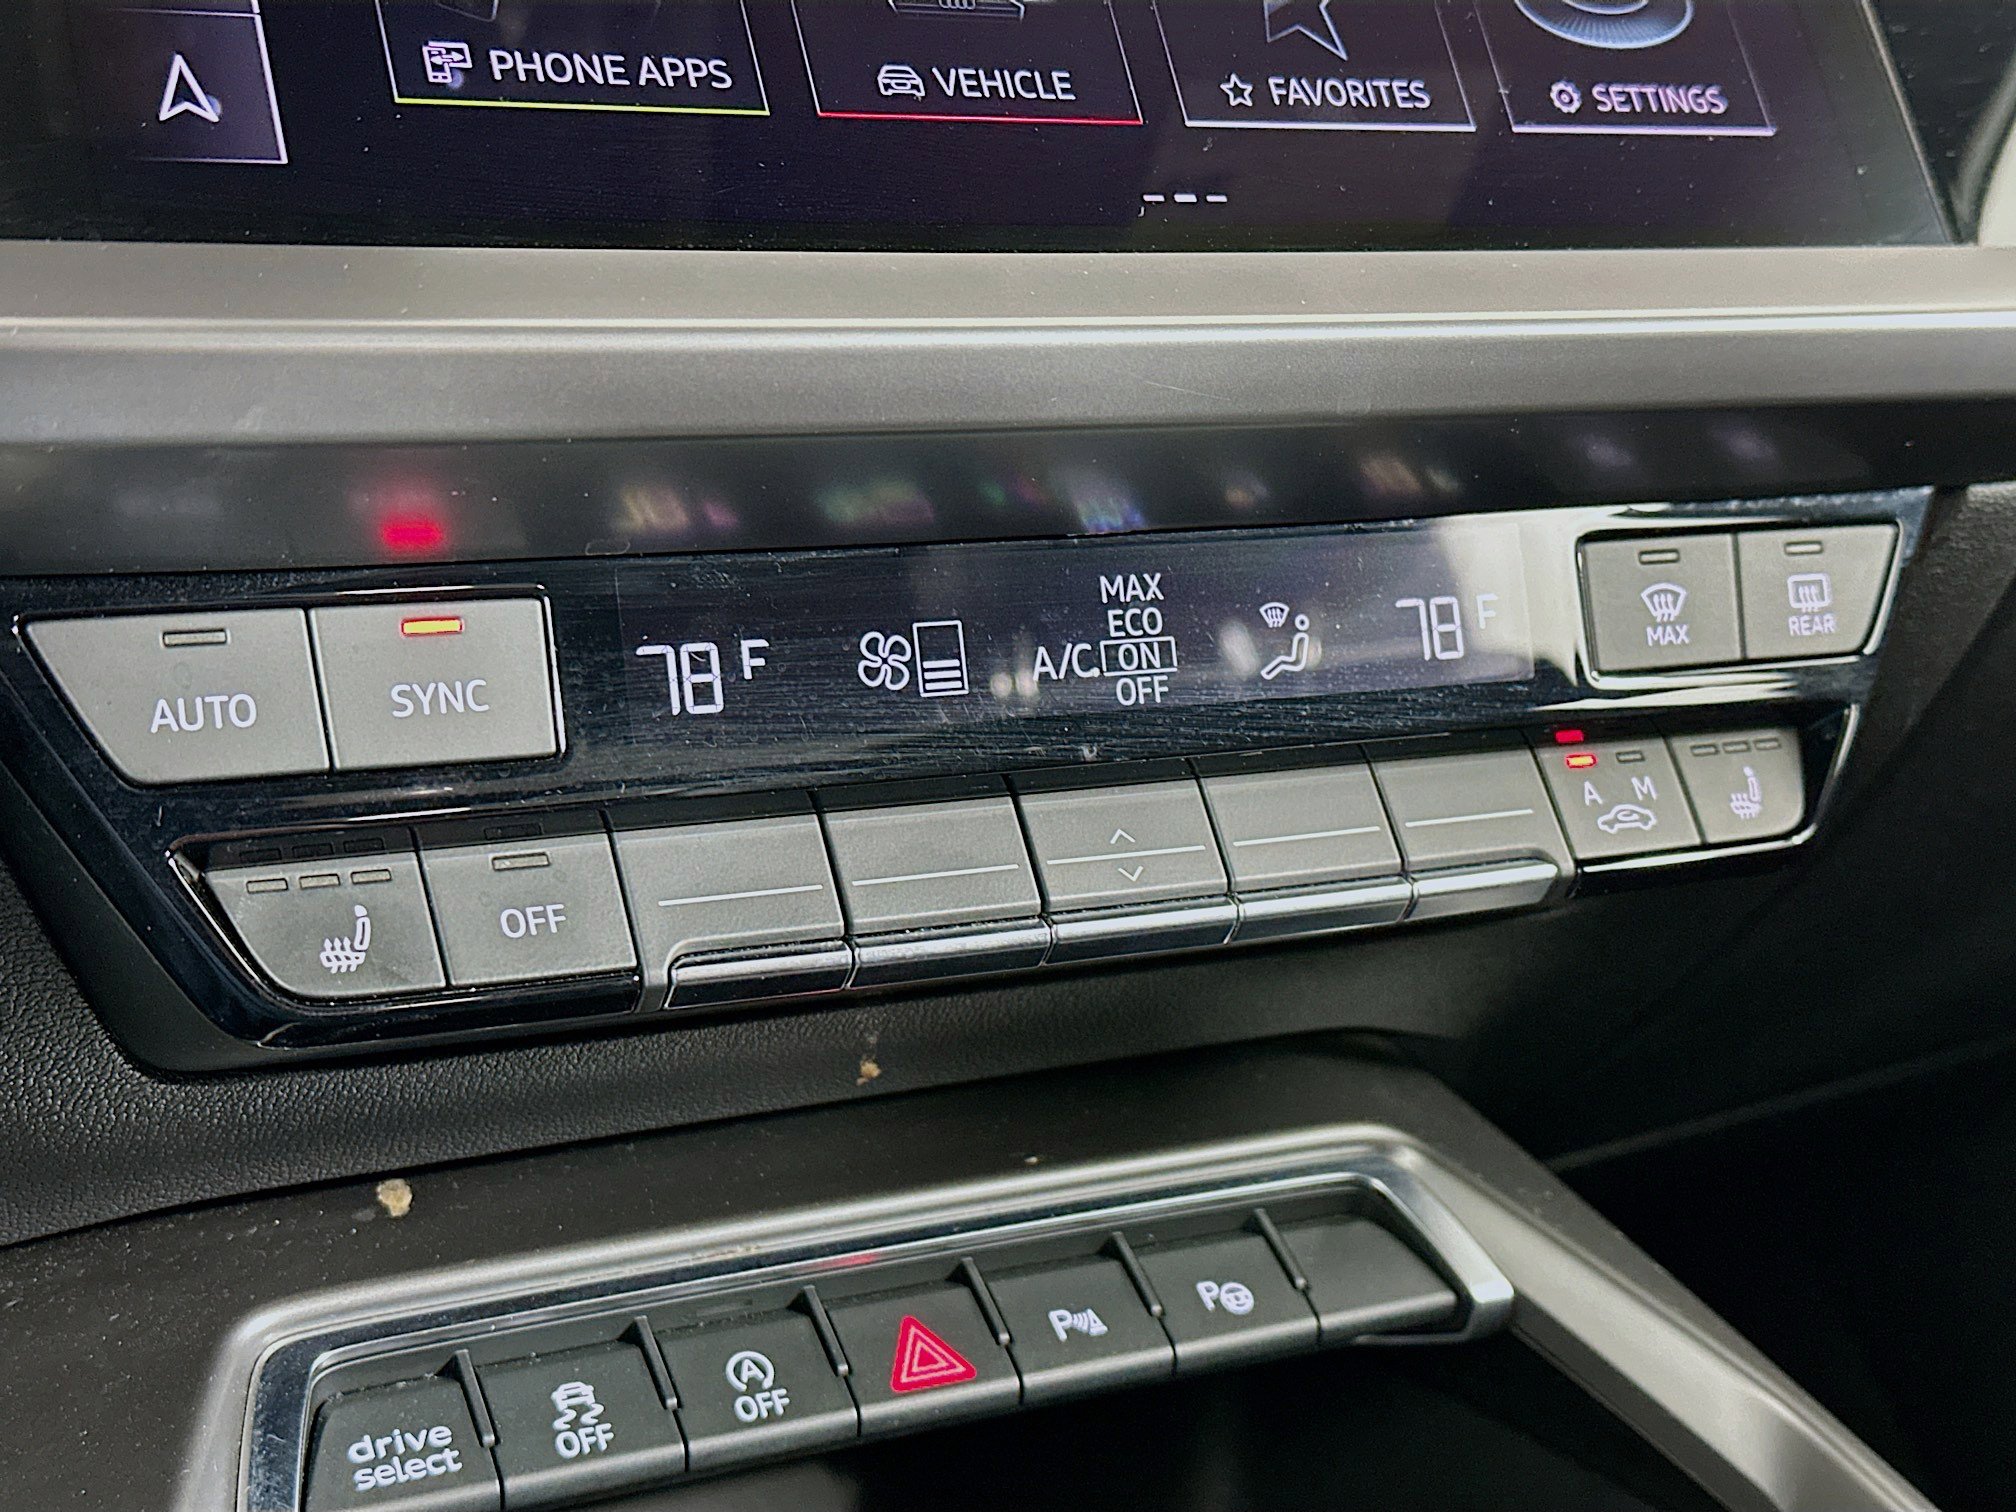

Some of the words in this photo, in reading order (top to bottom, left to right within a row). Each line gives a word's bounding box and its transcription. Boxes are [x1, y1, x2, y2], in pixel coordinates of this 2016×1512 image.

[489, 50, 630, 85] PHONE
[638, 55, 733, 89] APPS
[931, 67, 1076, 100] VEHICLE
[1269, 76, 1431, 109] FAVORITES
[1592, 83, 1727, 114] SETTINGS
[1100, 572, 1164, 603] MAX
[1107, 606, 1163, 638] ECO
[1395, 596, 1464, 661] 78
[1476, 593, 1499, 630] F
[1646, 624, 1689, 647] MAX
[1788, 614, 1836, 636] REAR
[635, 642, 725, 716] 78
[740, 638, 770, 680] F
[1033, 643, 1094, 682] A/C
[1117, 641, 1161, 671] ON
[391, 679, 490, 718] SYNC
[1116, 675, 1169, 706] OFF
[150, 693, 257, 734] AUTO
[1583, 781, 1603, 806] A
[1631, 776, 1658, 801] M
[500, 903, 567, 939] OFF
[732, 1388, 790, 1423] OFF
[347, 1425, 453, 1464] drive
[554, 1422, 615, 1459] OFF
[353, 1446, 464, 1491] select
